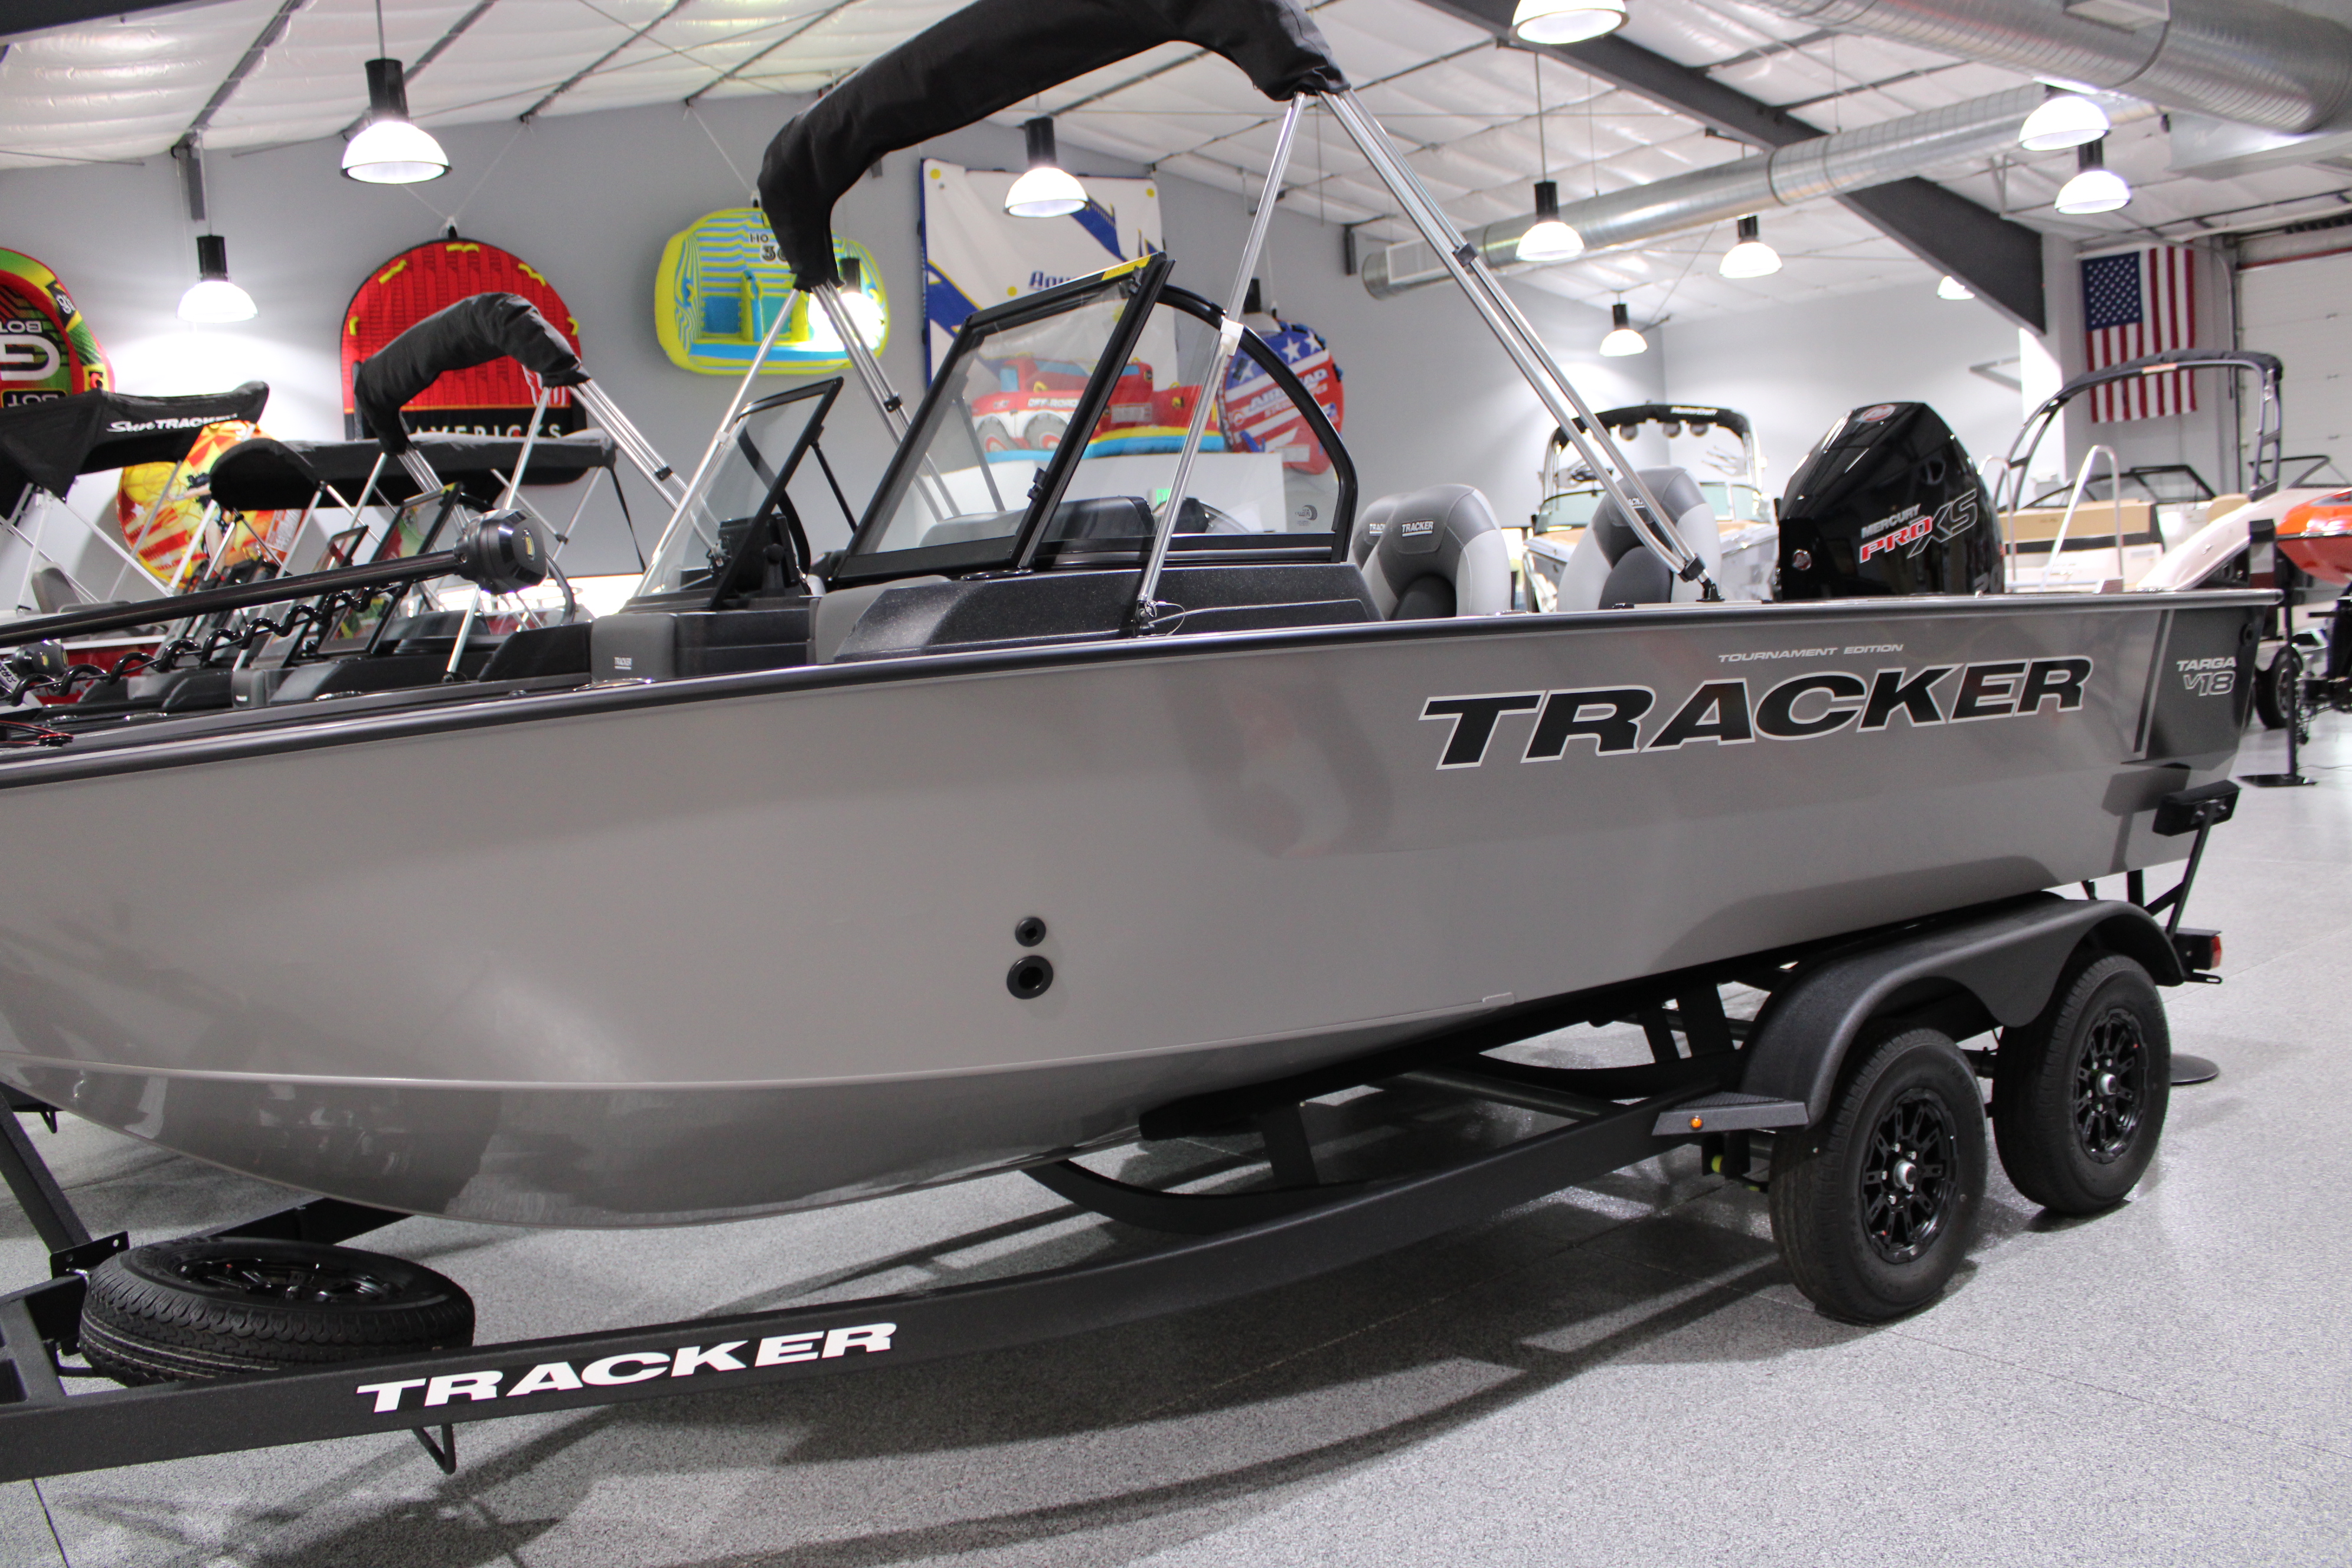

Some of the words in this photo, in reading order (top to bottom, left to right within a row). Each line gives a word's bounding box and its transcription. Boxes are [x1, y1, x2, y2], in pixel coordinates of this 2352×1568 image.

[1402, 520, 1433, 533] TRACKER
[1861, 503, 1921, 538] MERCURY
[1859, 515, 1933, 563] PRO
[1719, 647, 1838, 662] TOURNAMENT
[1843, 644, 1904, 655] EDITION
[2176, 656, 2237, 672] TARGA
[2183, 670, 2236, 697] V18
[1417, 654, 2095, 771] TRACKER
[357, 1322, 897, 1413] TRACKER
